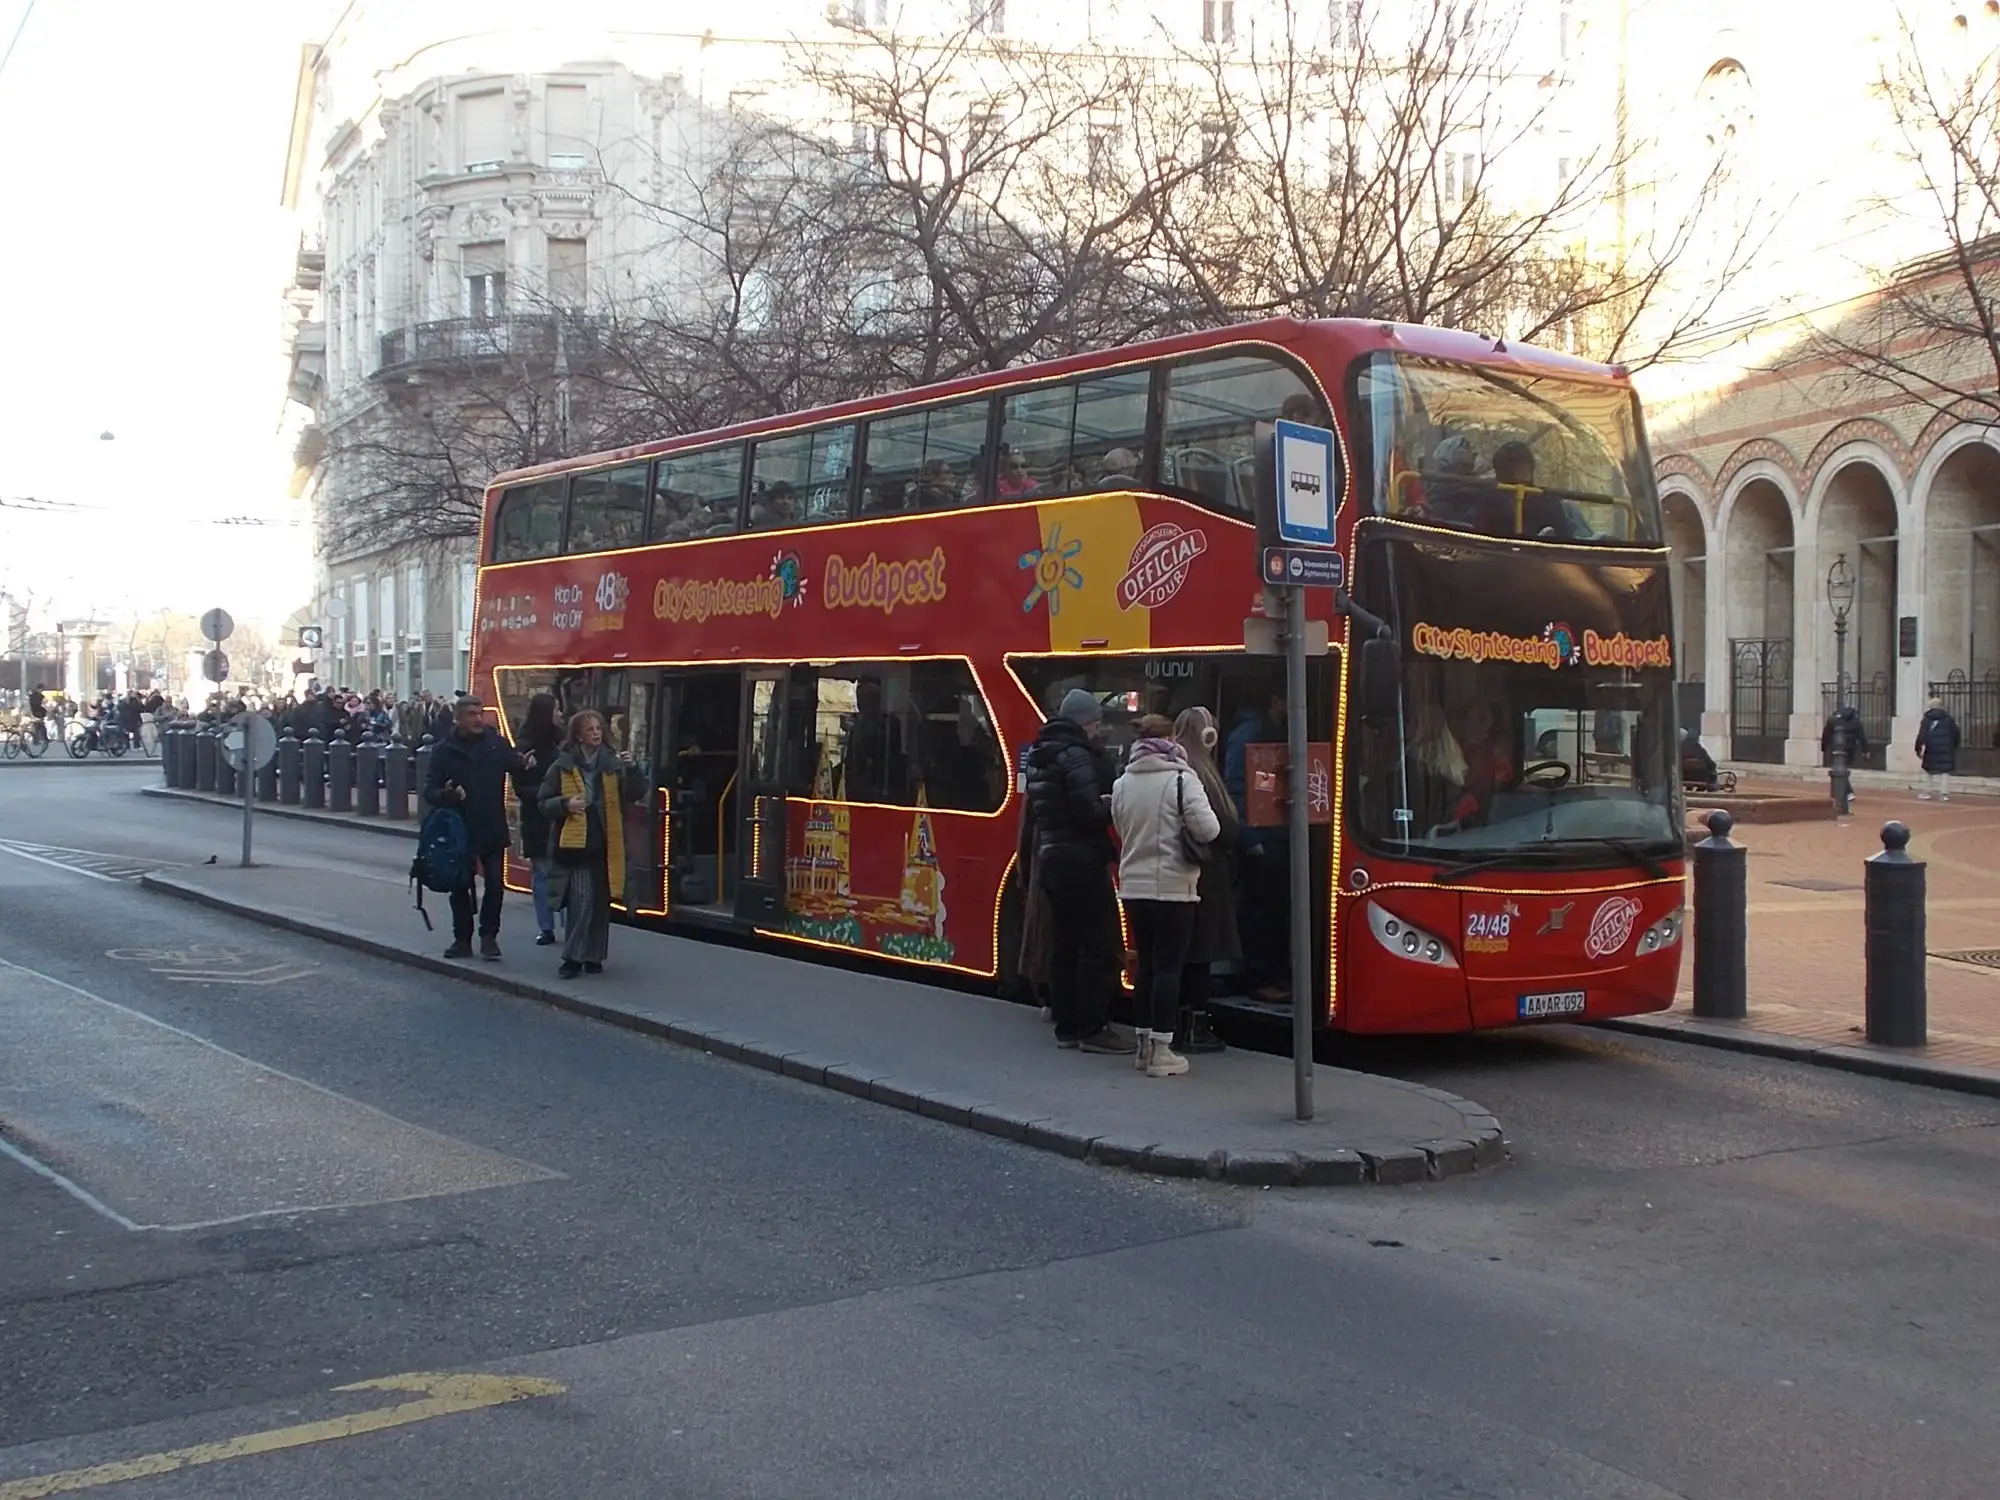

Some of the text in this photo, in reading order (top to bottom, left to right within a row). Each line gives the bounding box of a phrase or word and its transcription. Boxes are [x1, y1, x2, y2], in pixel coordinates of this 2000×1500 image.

[823, 546, 948, 615] Budapest
[1124, 534, 1202, 601] OFFICIAL
[1149, 570, 1185, 604] TOUR
[554, 585, 570, 605] Hop
[571, 584, 583, 604] On
[594, 571, 616, 612] 48
[552, 611, 569, 630] Hop
[569, 609, 585, 628] Off
[1583, 628, 1672, 671] Budapest
[1467, 913, 1511, 936] 24/48
[1591, 902, 1640, 950] OFFICIAL
